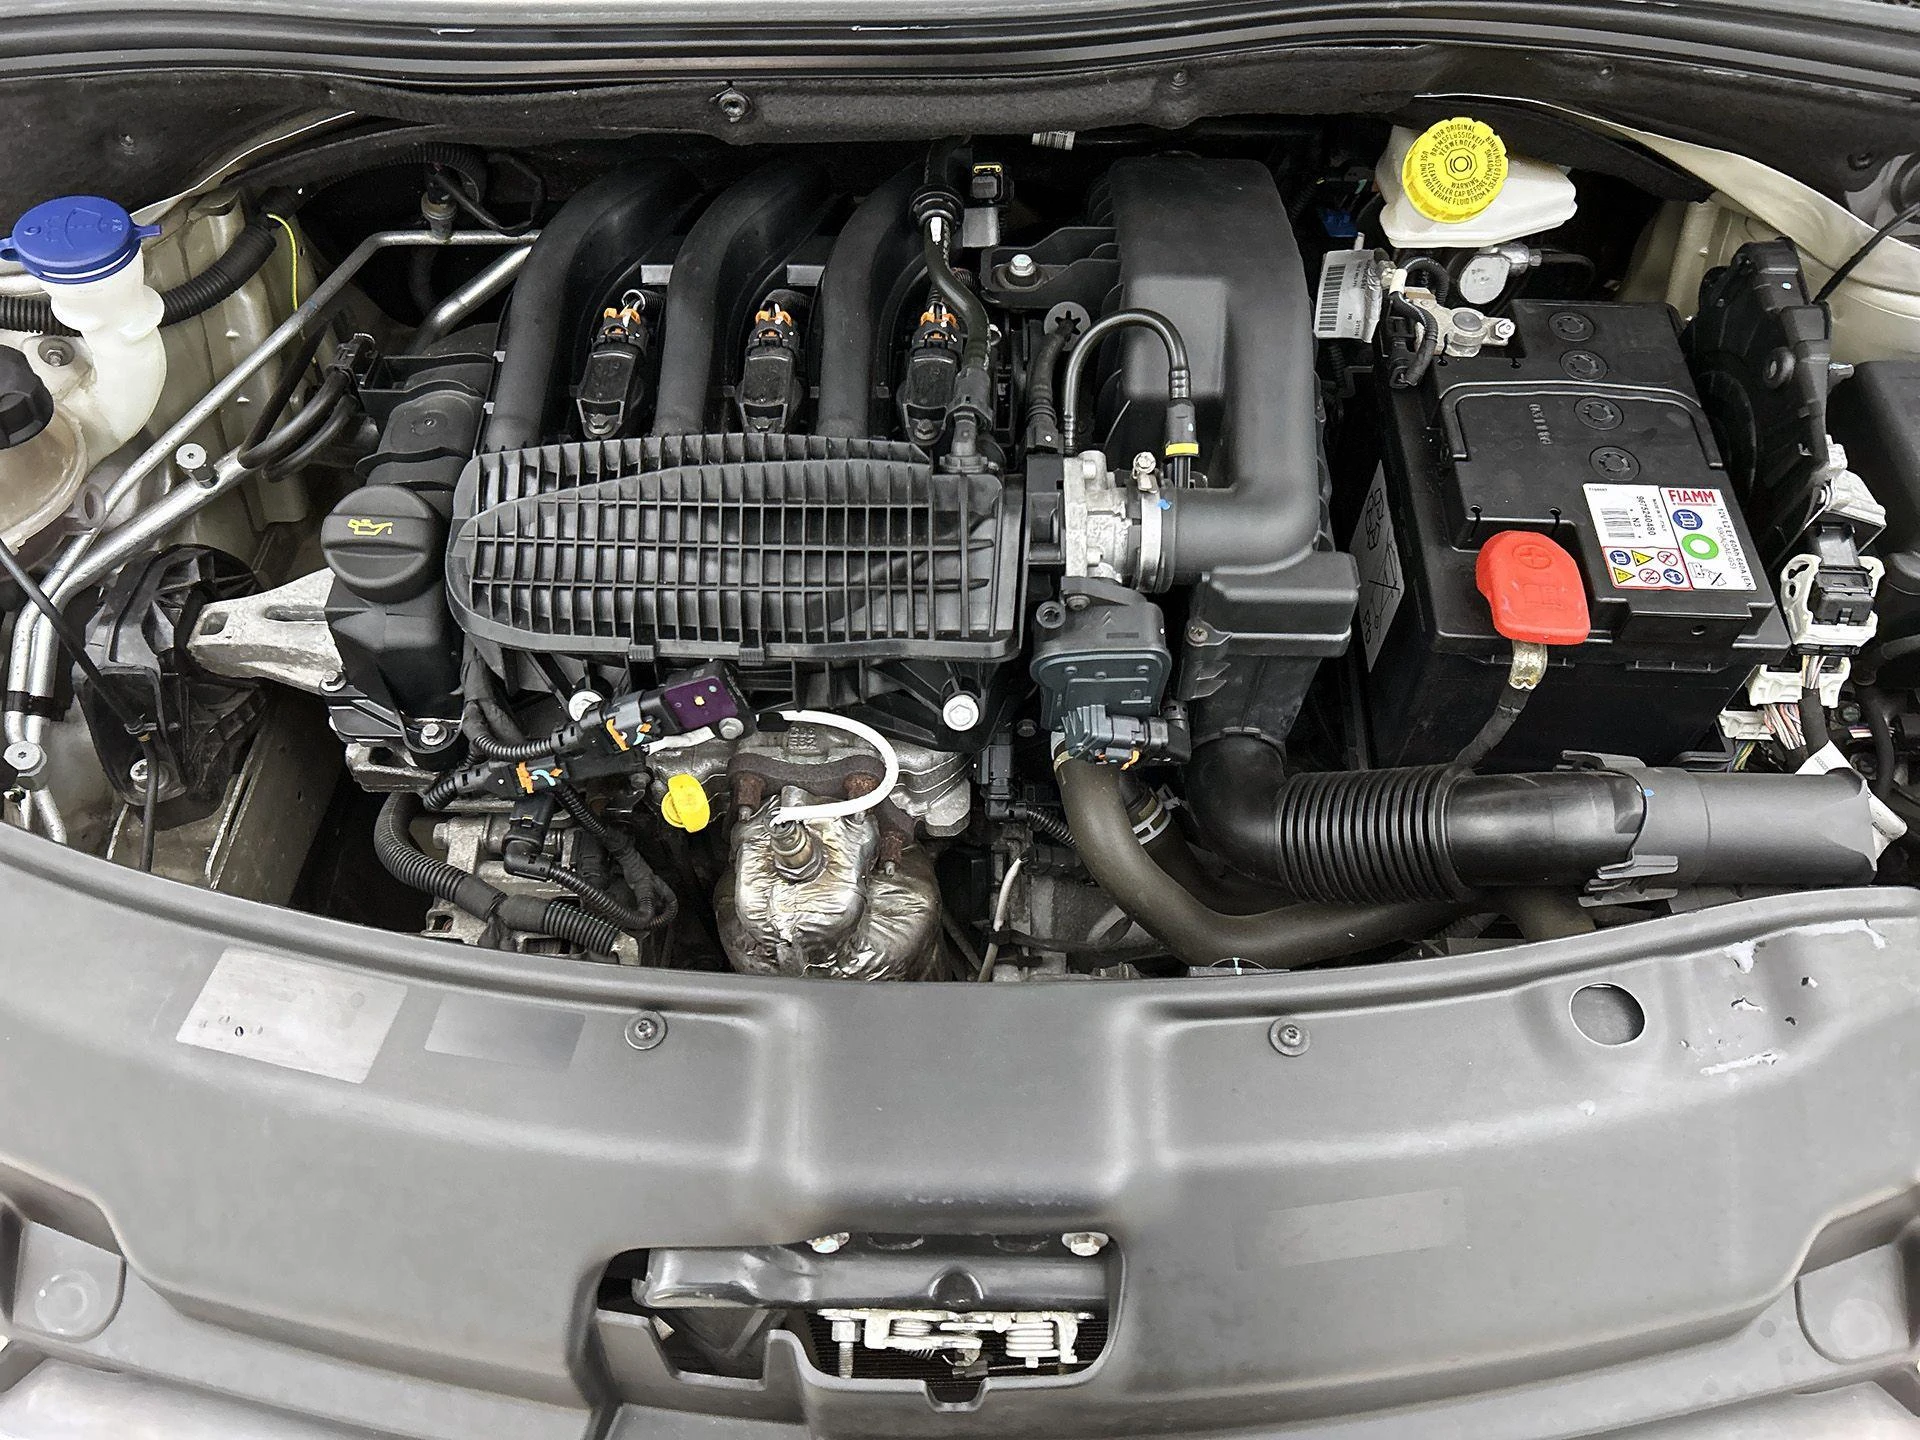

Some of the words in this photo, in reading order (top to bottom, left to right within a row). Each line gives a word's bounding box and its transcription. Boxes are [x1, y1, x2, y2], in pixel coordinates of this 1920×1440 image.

[1446, 124, 1475, 133] ORIGINAL
[1421, 151, 1429, 162] USE
[1420, 164, 1428, 178] ONLY
[1434, 180, 1453, 195] FILLER
[1467, 180, 1488, 196] BEFORE
[1484, 149, 1495, 180] REMOVING
[1451, 177, 1479, 189] WARNING
[1490, 168, 1501, 189] SEALED
[1433, 190, 1452, 204] BRAKE
[1470, 191, 1487, 203] FROM
[1668, 490, 1716, 503] FIAMM
[1633, 517, 1641, 528] N3
[1718, 508, 1726, 519] 12V
[1726, 530, 1734, 538] EF
[1730, 539, 1740, 557] 60Ah
[1736, 558, 1746, 574] 640A
